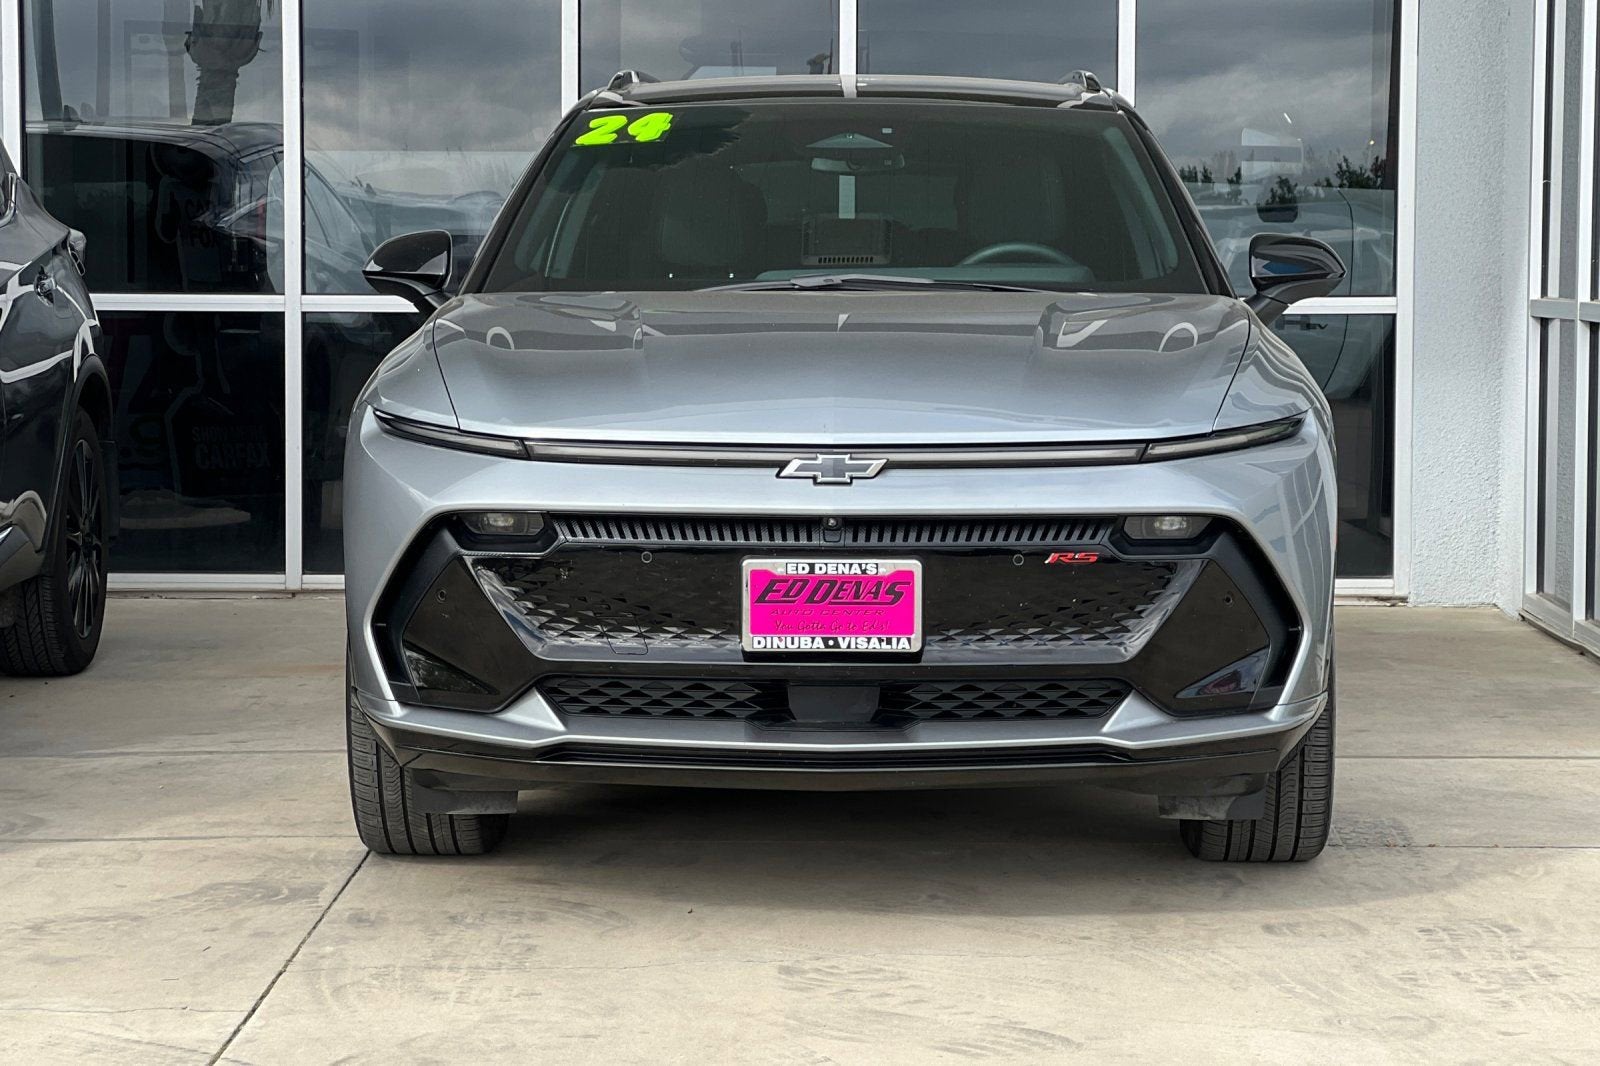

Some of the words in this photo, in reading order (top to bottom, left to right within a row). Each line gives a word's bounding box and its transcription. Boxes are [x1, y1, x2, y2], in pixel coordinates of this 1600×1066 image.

[575, 112, 673, 146] 24
[194, 442, 272, 470] CARFAX
[1044, 552, 1099, 564] RS
[787, 563, 809, 575] ED
[814, 563, 878, 575] DENA'S
[755, 579, 810, 605] ED
[775, 620, 794, 631] You
[797, 620, 826, 632] Gotta
[829, 620, 842, 633] Go
[847, 621, 857, 631] to
[753, 637, 825, 649] DINUBA
[836, 637, 911, 649] VISALIA
